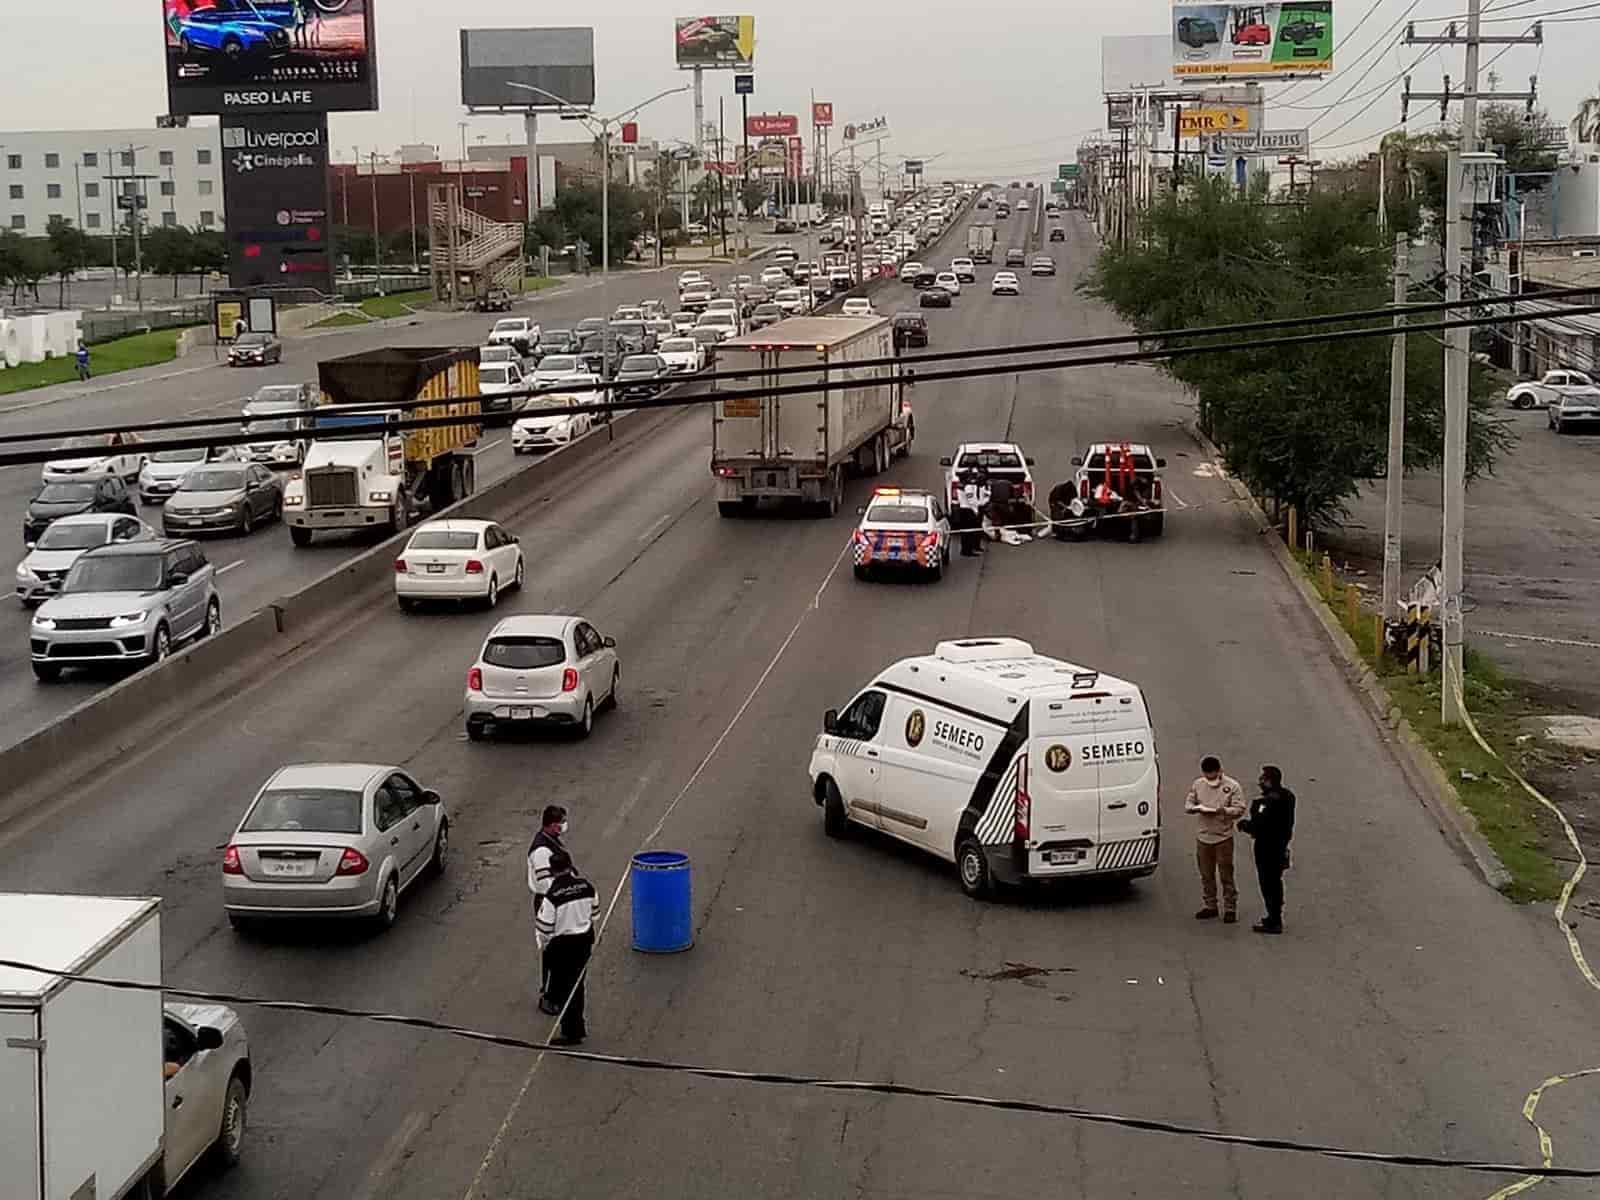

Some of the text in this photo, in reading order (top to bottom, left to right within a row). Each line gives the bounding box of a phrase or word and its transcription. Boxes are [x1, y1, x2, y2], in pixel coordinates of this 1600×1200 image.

[224, 92, 269, 105] PASEO
[293, 91, 312, 103] FE
[1180, 117, 1215, 129] TMR
[247, 128, 319, 148] Liverpool
[254, 153, 313, 168] Cinépolis
[934, 720, 984, 752] SEMEFO
[1081, 741, 1145, 760] SEMEFO
